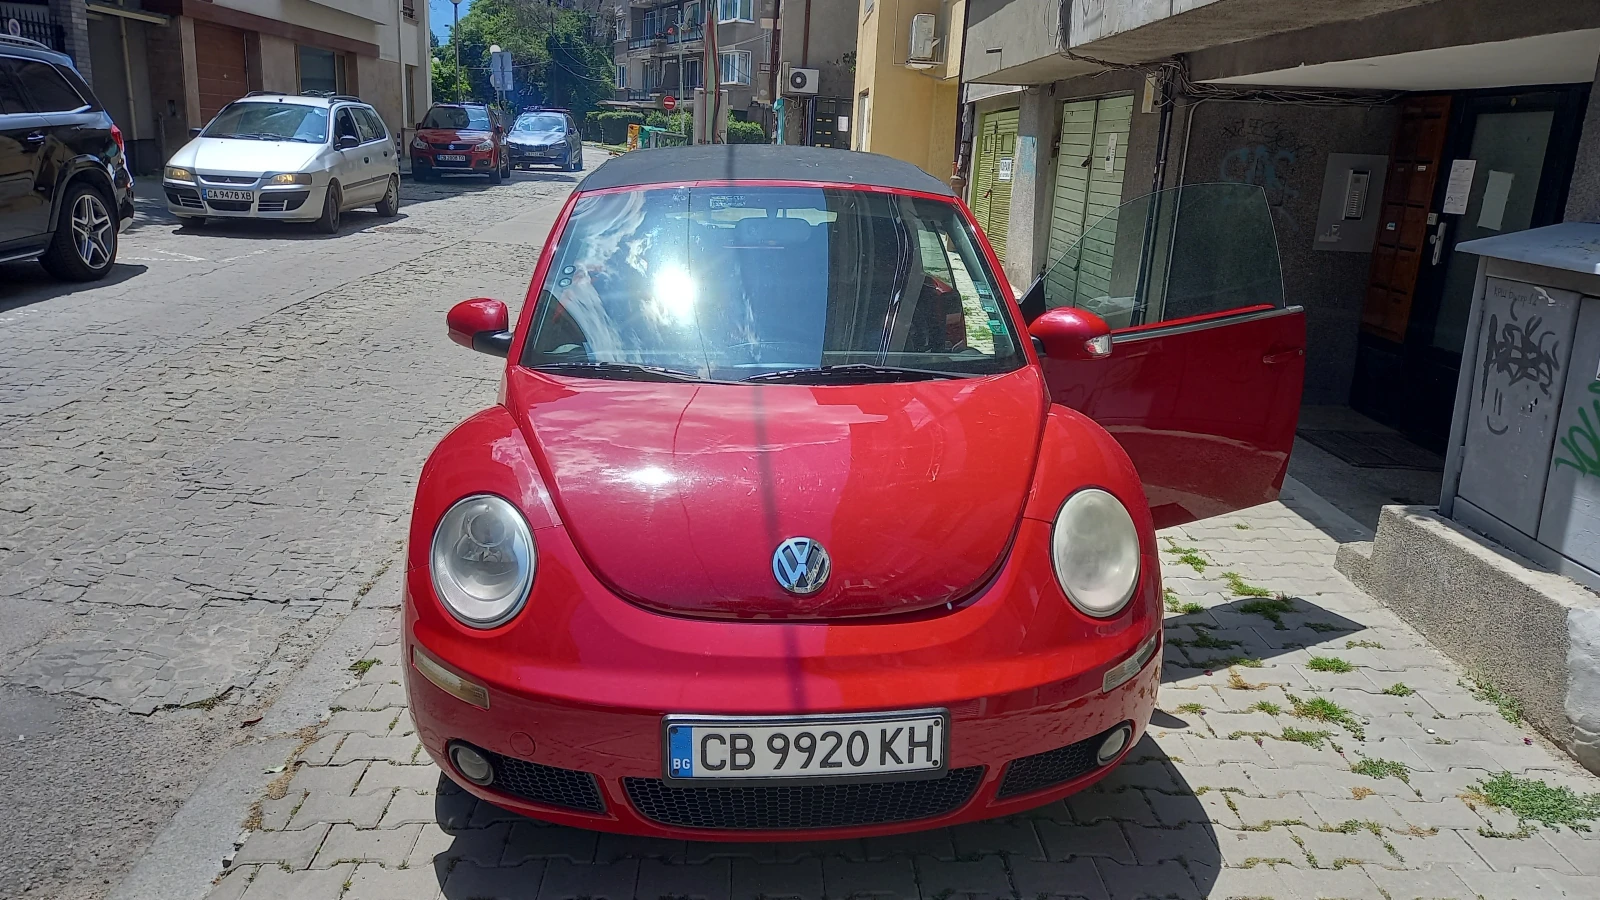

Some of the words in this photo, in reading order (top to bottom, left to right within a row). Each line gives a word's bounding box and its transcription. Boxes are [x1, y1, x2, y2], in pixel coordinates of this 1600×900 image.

[207, 190, 219, 199] CA
[219, 191, 240, 200] 9478
[240, 192, 252, 200] XB
[700, 733, 756, 771] CB
[766, 730, 869, 770] 9920
[879, 724, 934, 766] KH
[673, 758, 691, 769] BG
